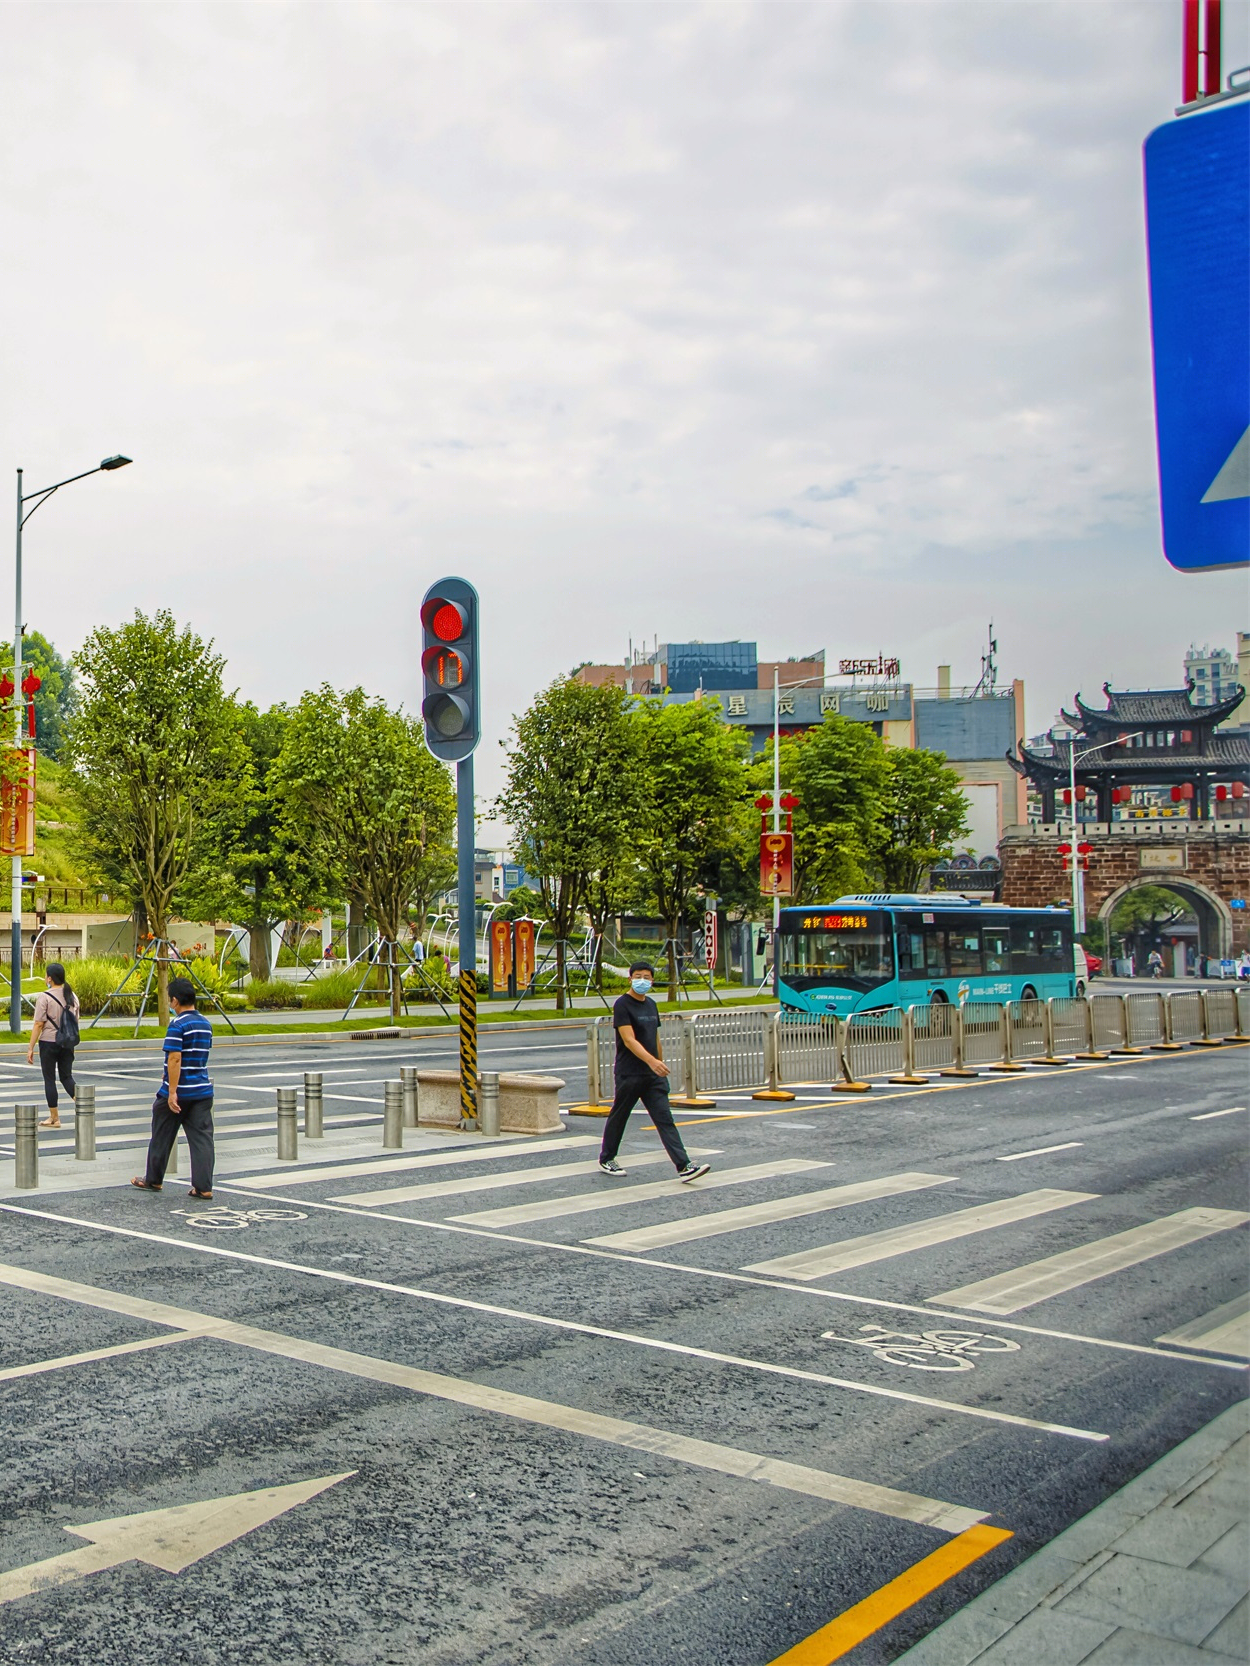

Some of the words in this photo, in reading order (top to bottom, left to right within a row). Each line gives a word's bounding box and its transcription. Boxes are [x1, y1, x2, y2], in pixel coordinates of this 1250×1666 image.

[438, 652, 463, 685] 17
[728, 694, 889, 716] 星辰网咖
